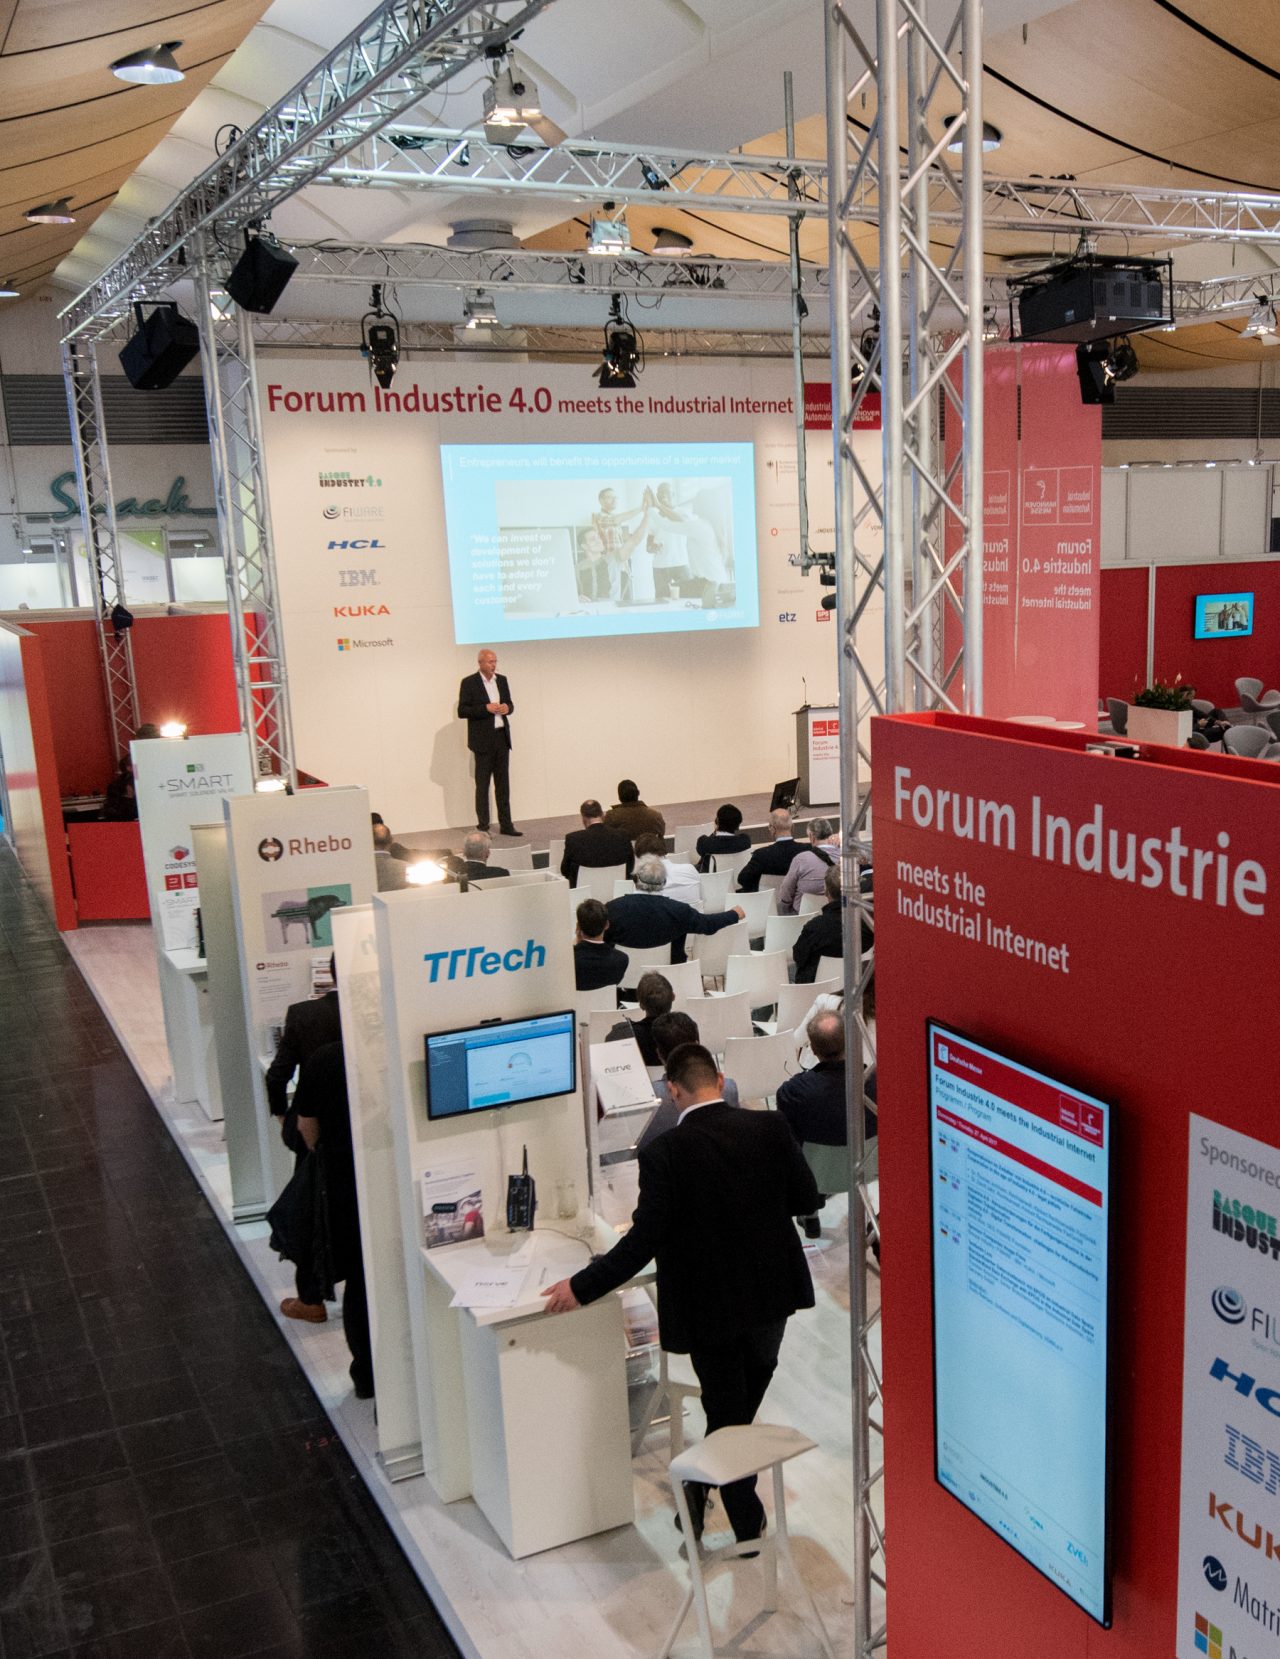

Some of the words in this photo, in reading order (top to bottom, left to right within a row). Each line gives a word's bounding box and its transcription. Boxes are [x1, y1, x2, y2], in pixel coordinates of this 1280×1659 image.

[267, 383, 366, 412] Forum
[375, 383, 502, 413] Industrie
[508, 386, 552, 413] 4.0
[558, 396, 611, 413] meets
[615, 395, 644, 413] the
[648, 395, 725, 413] Industrial
[730, 396, 793, 413] Internet
[531, 456, 548, 466] will
[584, 456, 599, 466] the
[343, 506, 384, 517] FIWARE
[327, 539, 386, 550] HCL
[495, 535, 509, 543] can
[511, 533, 536, 543] invest
[538, 534, 552, 542] on
[471, 545, 529, 557] development
[532, 544, 542, 554] of
[471, 558, 514, 568] solutions
[516, 559, 530, 567] we
[338, 569, 378, 587] IBM
[472, 571, 495, 580] have
[497, 571, 508, 580] to
[509, 569, 534, 581] adapt
[536, 568, 549, 578] for
[473, 582, 496, 592] each
[498, 582, 515, 592] and
[517, 583, 542, 594] every
[334, 605, 391, 617] KUKA
[779, 612, 797, 623] etz
[352, 637, 394, 649] Microsoft
[288, 835, 352, 856] Rhebo
[894, 765, 1016, 851] Forum
[1032, 795, 1267, 916] Industrie
[897, 859, 950, 896] meets
[954, 870, 986, 907] the
[897, 888, 981, 942] Industrial
[986, 917, 1070, 974] Internet
[423, 938, 546, 984] TTTech
[935, 1072, 955, 1092] Forum
[955, 1083, 984, 1107] Industrie
[984, 1097, 995, 1112] 4.0
[996, 1104, 1016, 1123] meets
[1017, 1114, 1029, 1130] the
[1030, 1120, 1064, 1147] Industrial
[1065, 1138, 1096, 1164] Internet
[1213, 1189, 1278, 1236] BASQUE
